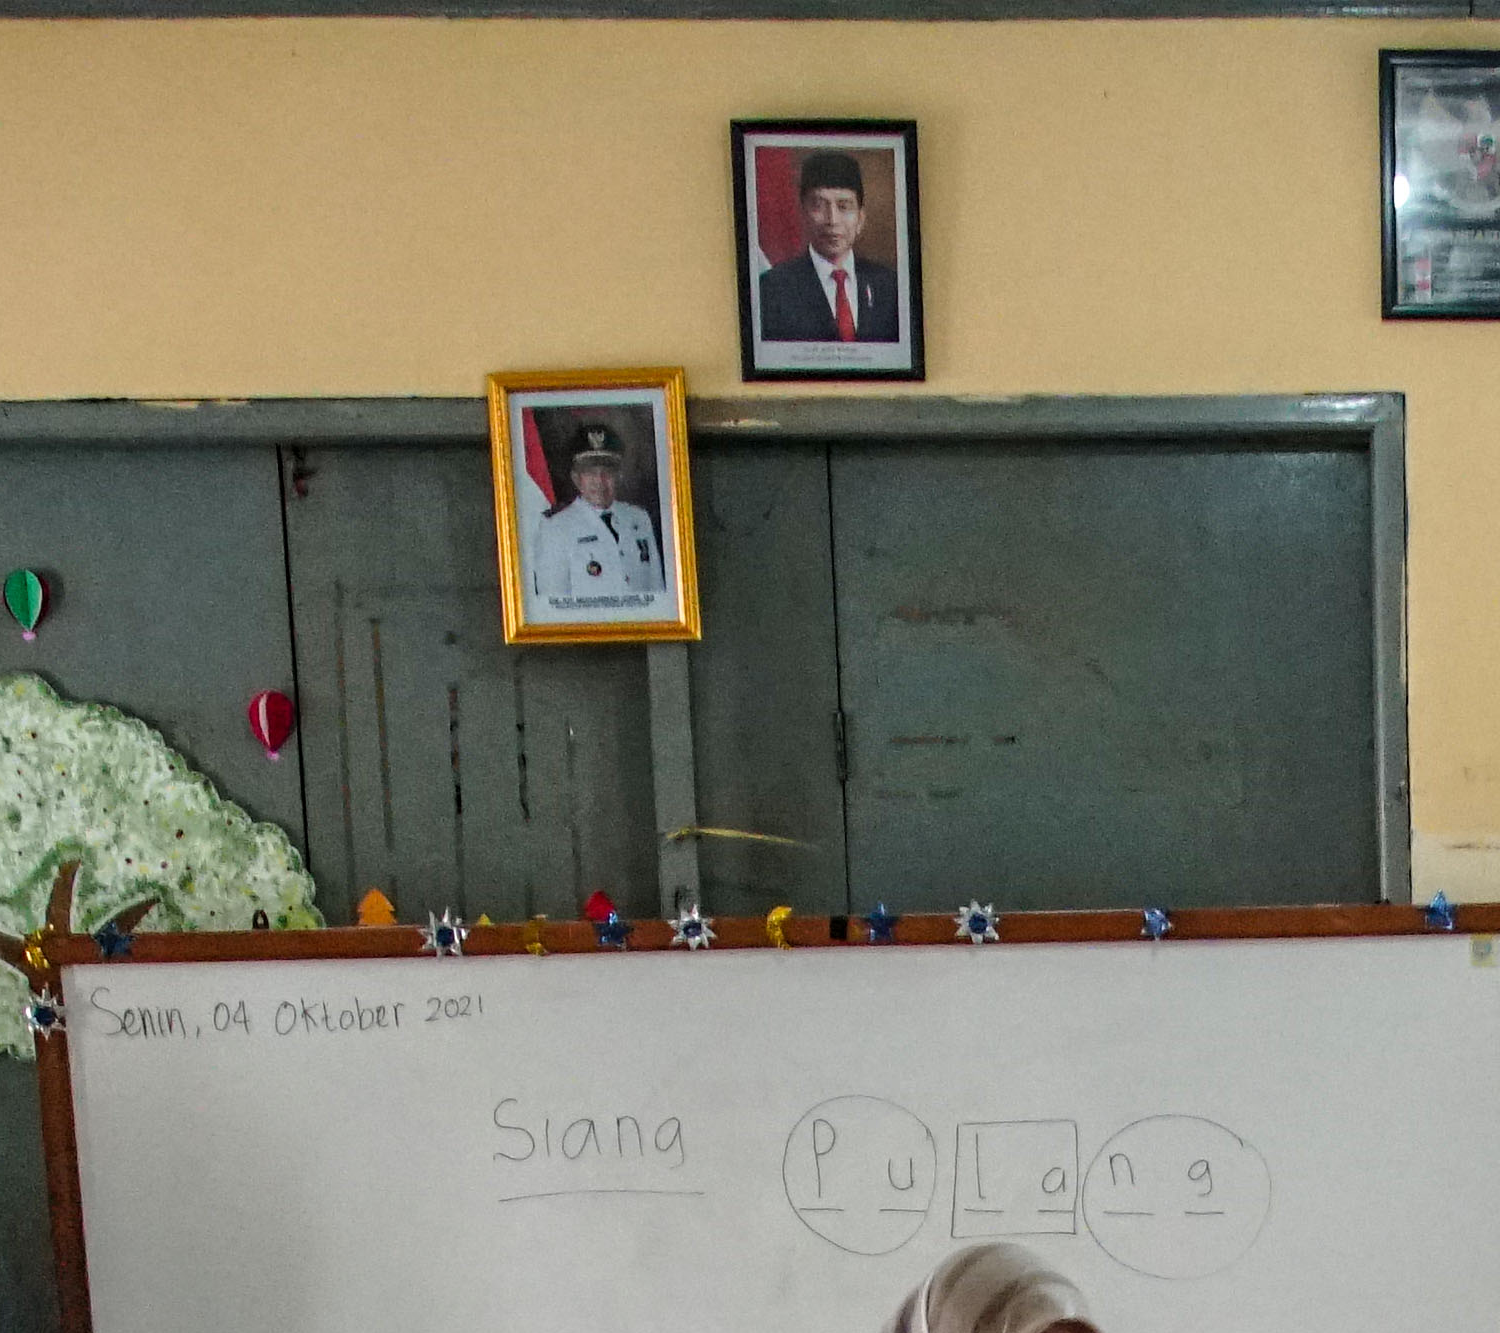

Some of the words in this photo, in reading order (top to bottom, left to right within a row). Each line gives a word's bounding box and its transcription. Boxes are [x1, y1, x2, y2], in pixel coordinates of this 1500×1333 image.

[91, 988, 201, 1039] Senin,
[213, 1001, 250, 1035] 04
[424, 995, 483, 1022] 2021
